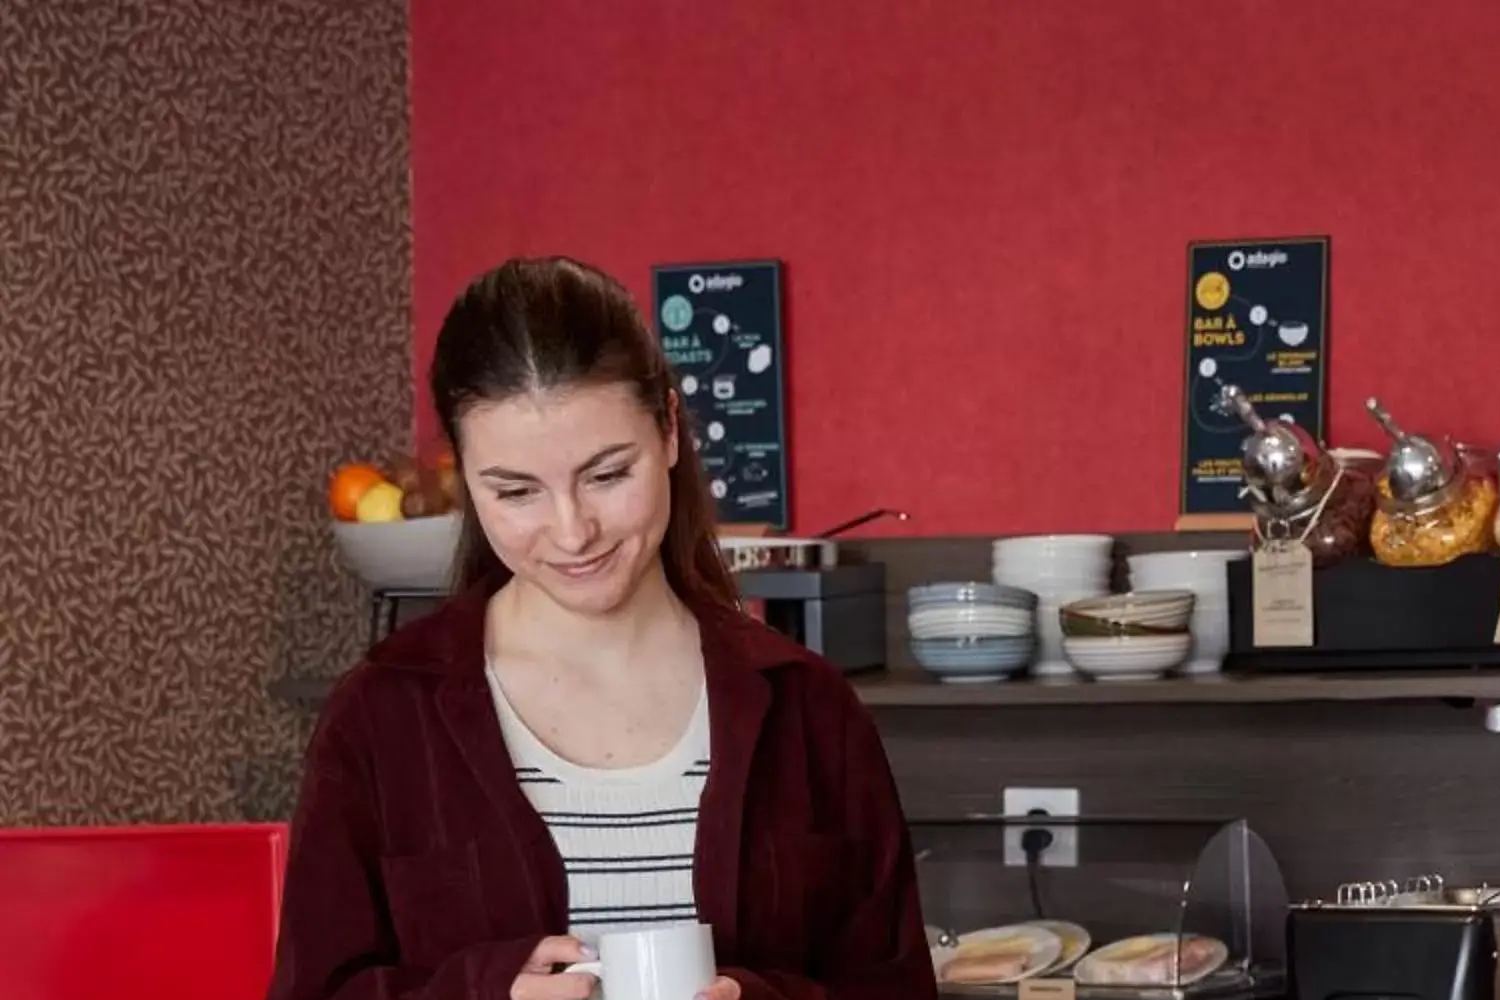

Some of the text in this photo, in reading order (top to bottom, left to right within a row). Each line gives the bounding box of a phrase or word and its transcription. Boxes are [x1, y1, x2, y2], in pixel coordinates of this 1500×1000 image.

[1194, 313, 1237, 331] BAR À
[662, 335, 690, 349] BAR
[1193, 331, 1245, 347] BOWLS
